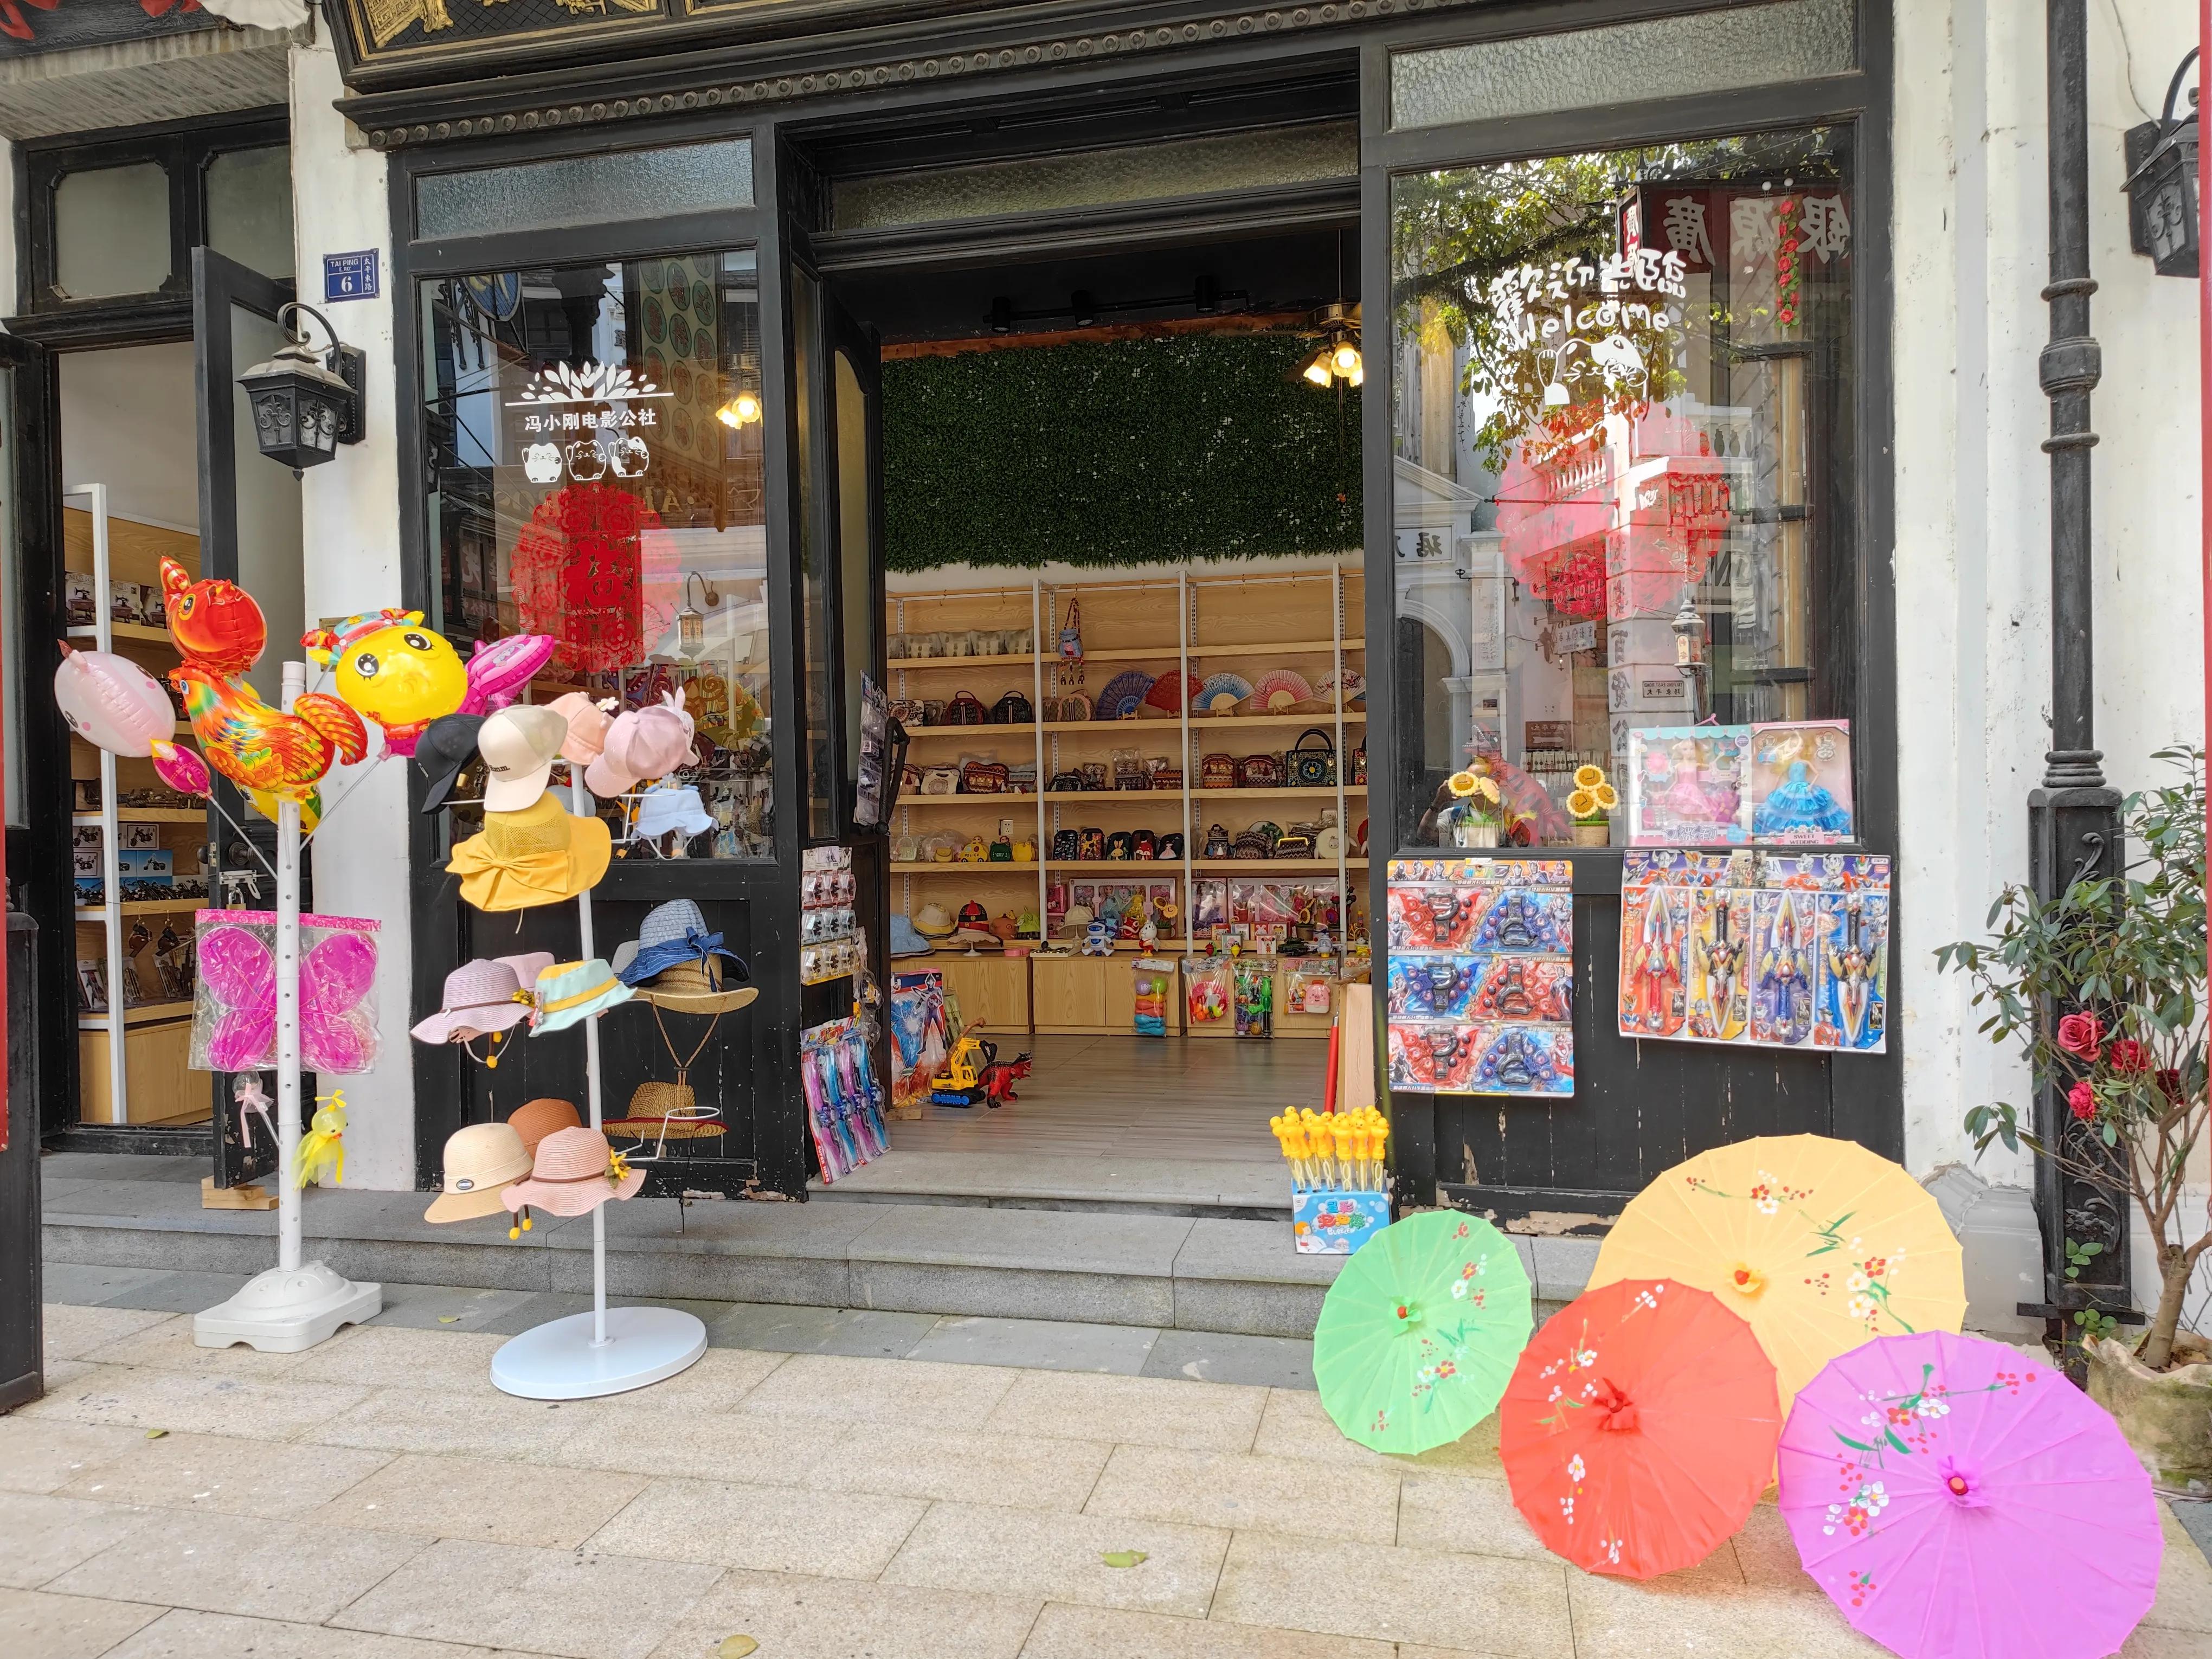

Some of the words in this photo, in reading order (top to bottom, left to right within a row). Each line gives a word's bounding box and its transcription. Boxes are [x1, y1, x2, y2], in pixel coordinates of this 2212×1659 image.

[342, 276, 352, 292] 6
[1508, 304, 1669, 350] Welcome
[524, 408, 657, 433] 冯小刚电影公社
